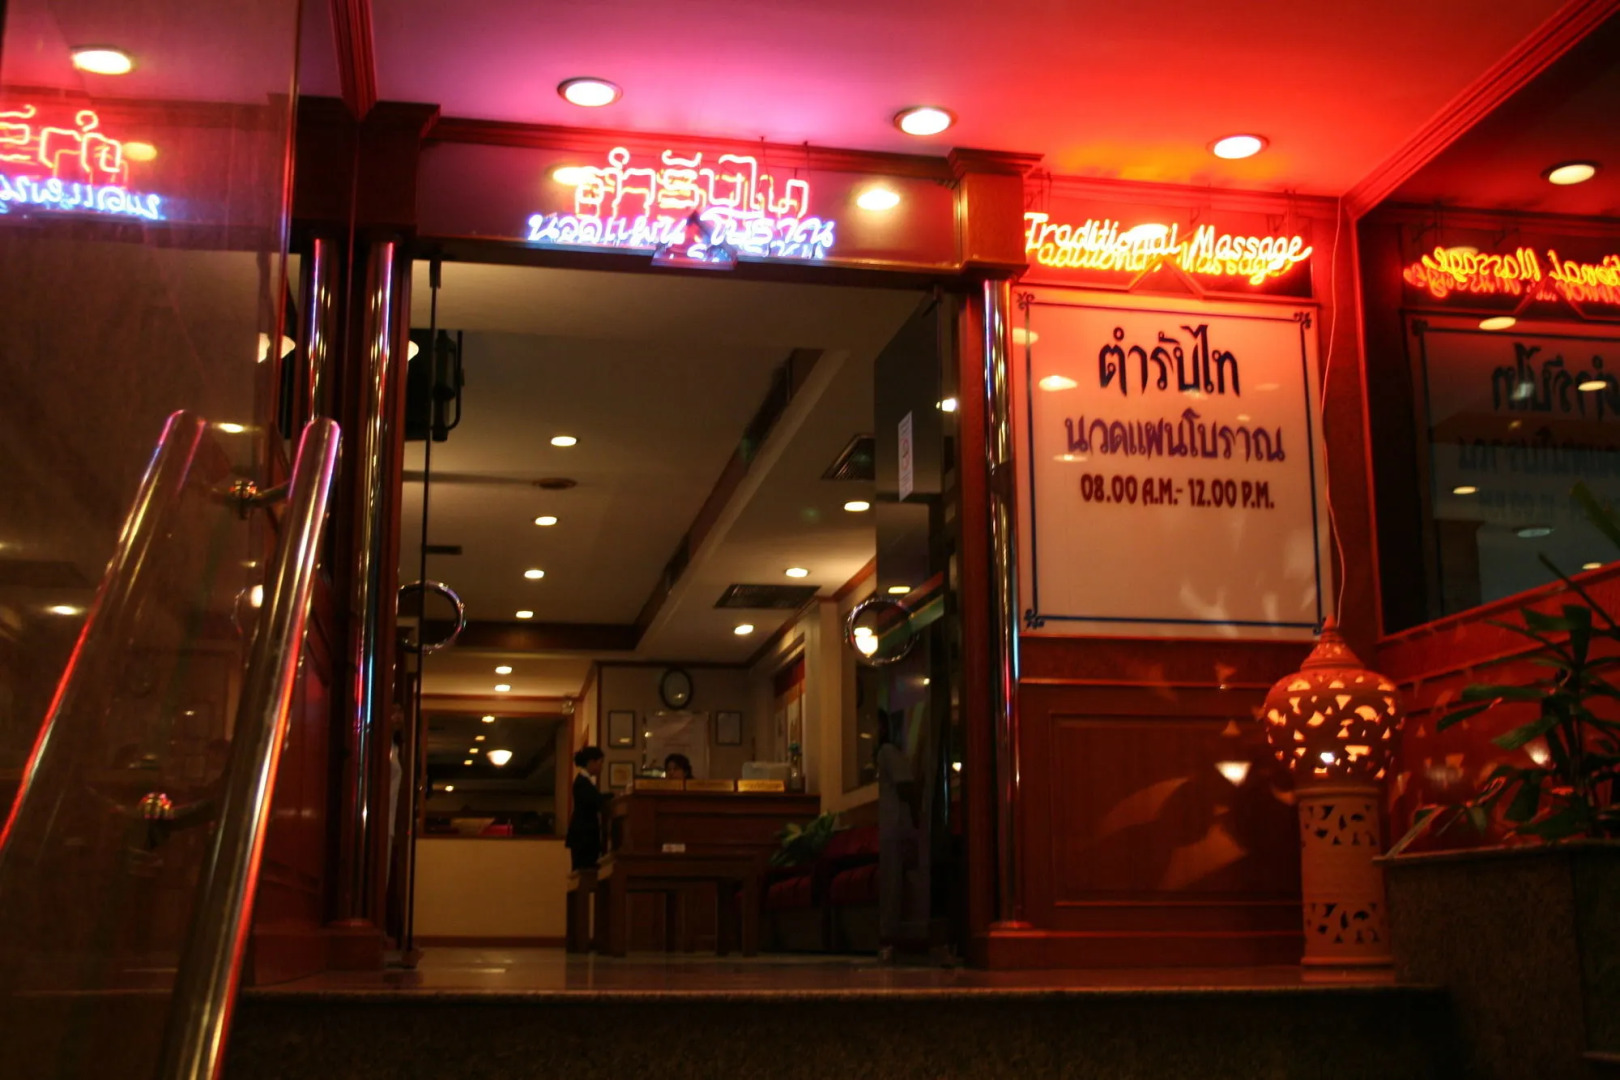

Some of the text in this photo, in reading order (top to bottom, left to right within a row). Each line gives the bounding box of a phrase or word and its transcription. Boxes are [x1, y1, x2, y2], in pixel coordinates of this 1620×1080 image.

[1024, 212, 1314, 270] Traditional Massage
[1099, 324, 1241, 397] ตำรับไท
[1064, 407, 1286, 462] นวดแผนโบราณ
[1080, 473, 1138, 504] 08.00
[1188, 479, 1238, 508] 12.00
[1242, 482, 1275, 509] P.M.
